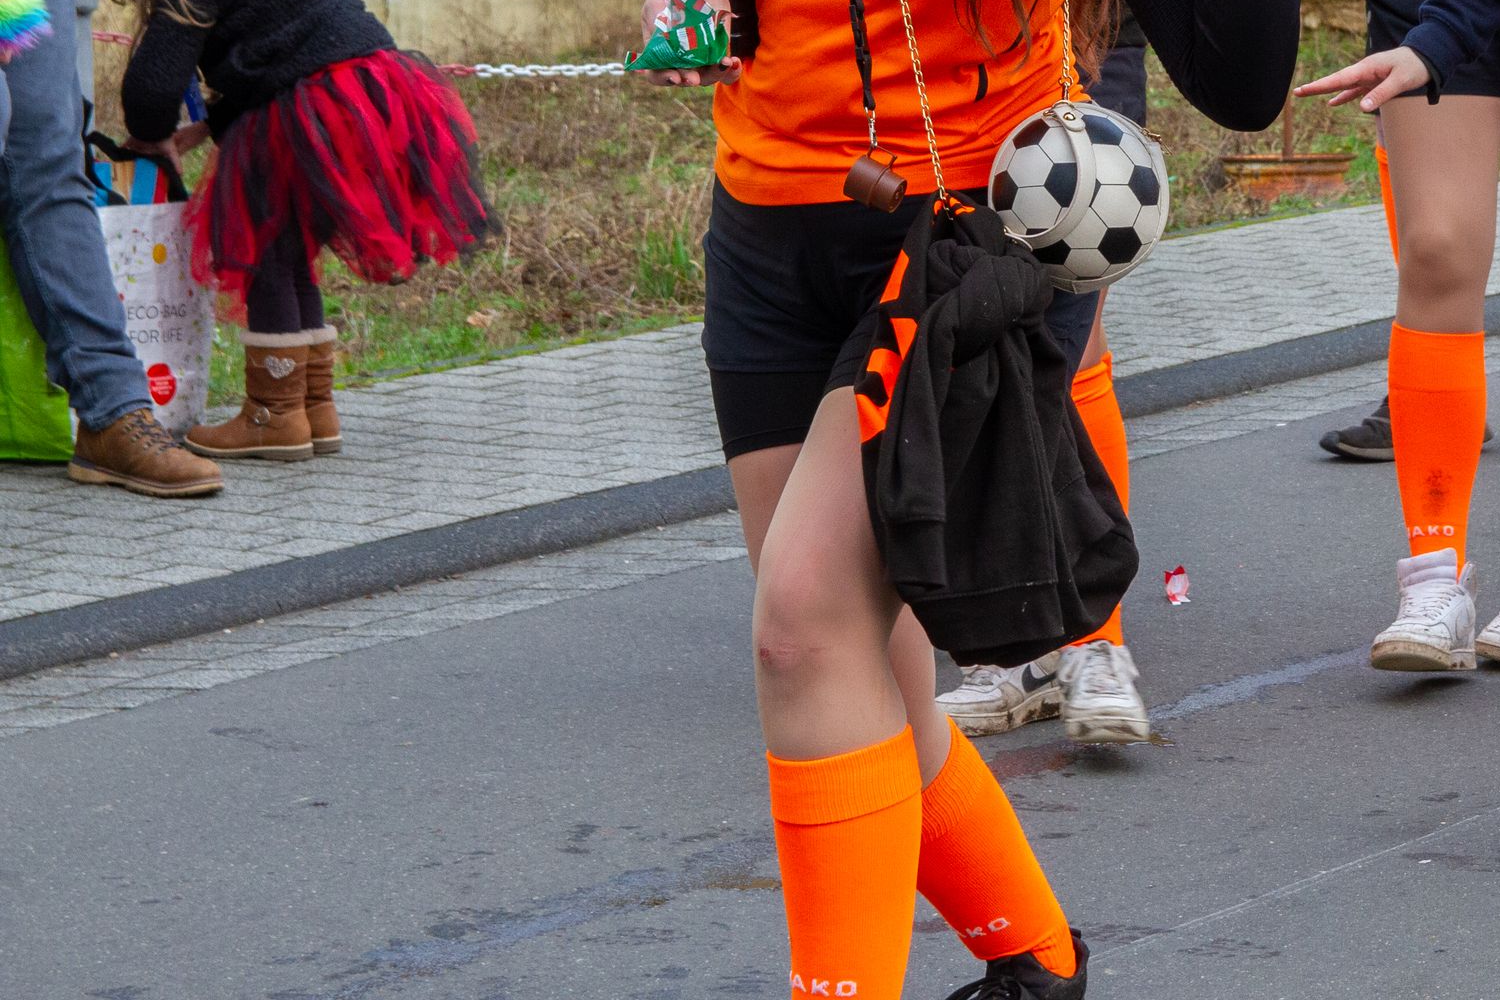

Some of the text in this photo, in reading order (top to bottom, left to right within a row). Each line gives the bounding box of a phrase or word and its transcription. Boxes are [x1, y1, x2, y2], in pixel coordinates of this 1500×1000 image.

[127, 303, 187, 321] ECO-BAG
[129, 327, 184, 345] FOR LIFE
[789, 969, 858, 998] AKO
